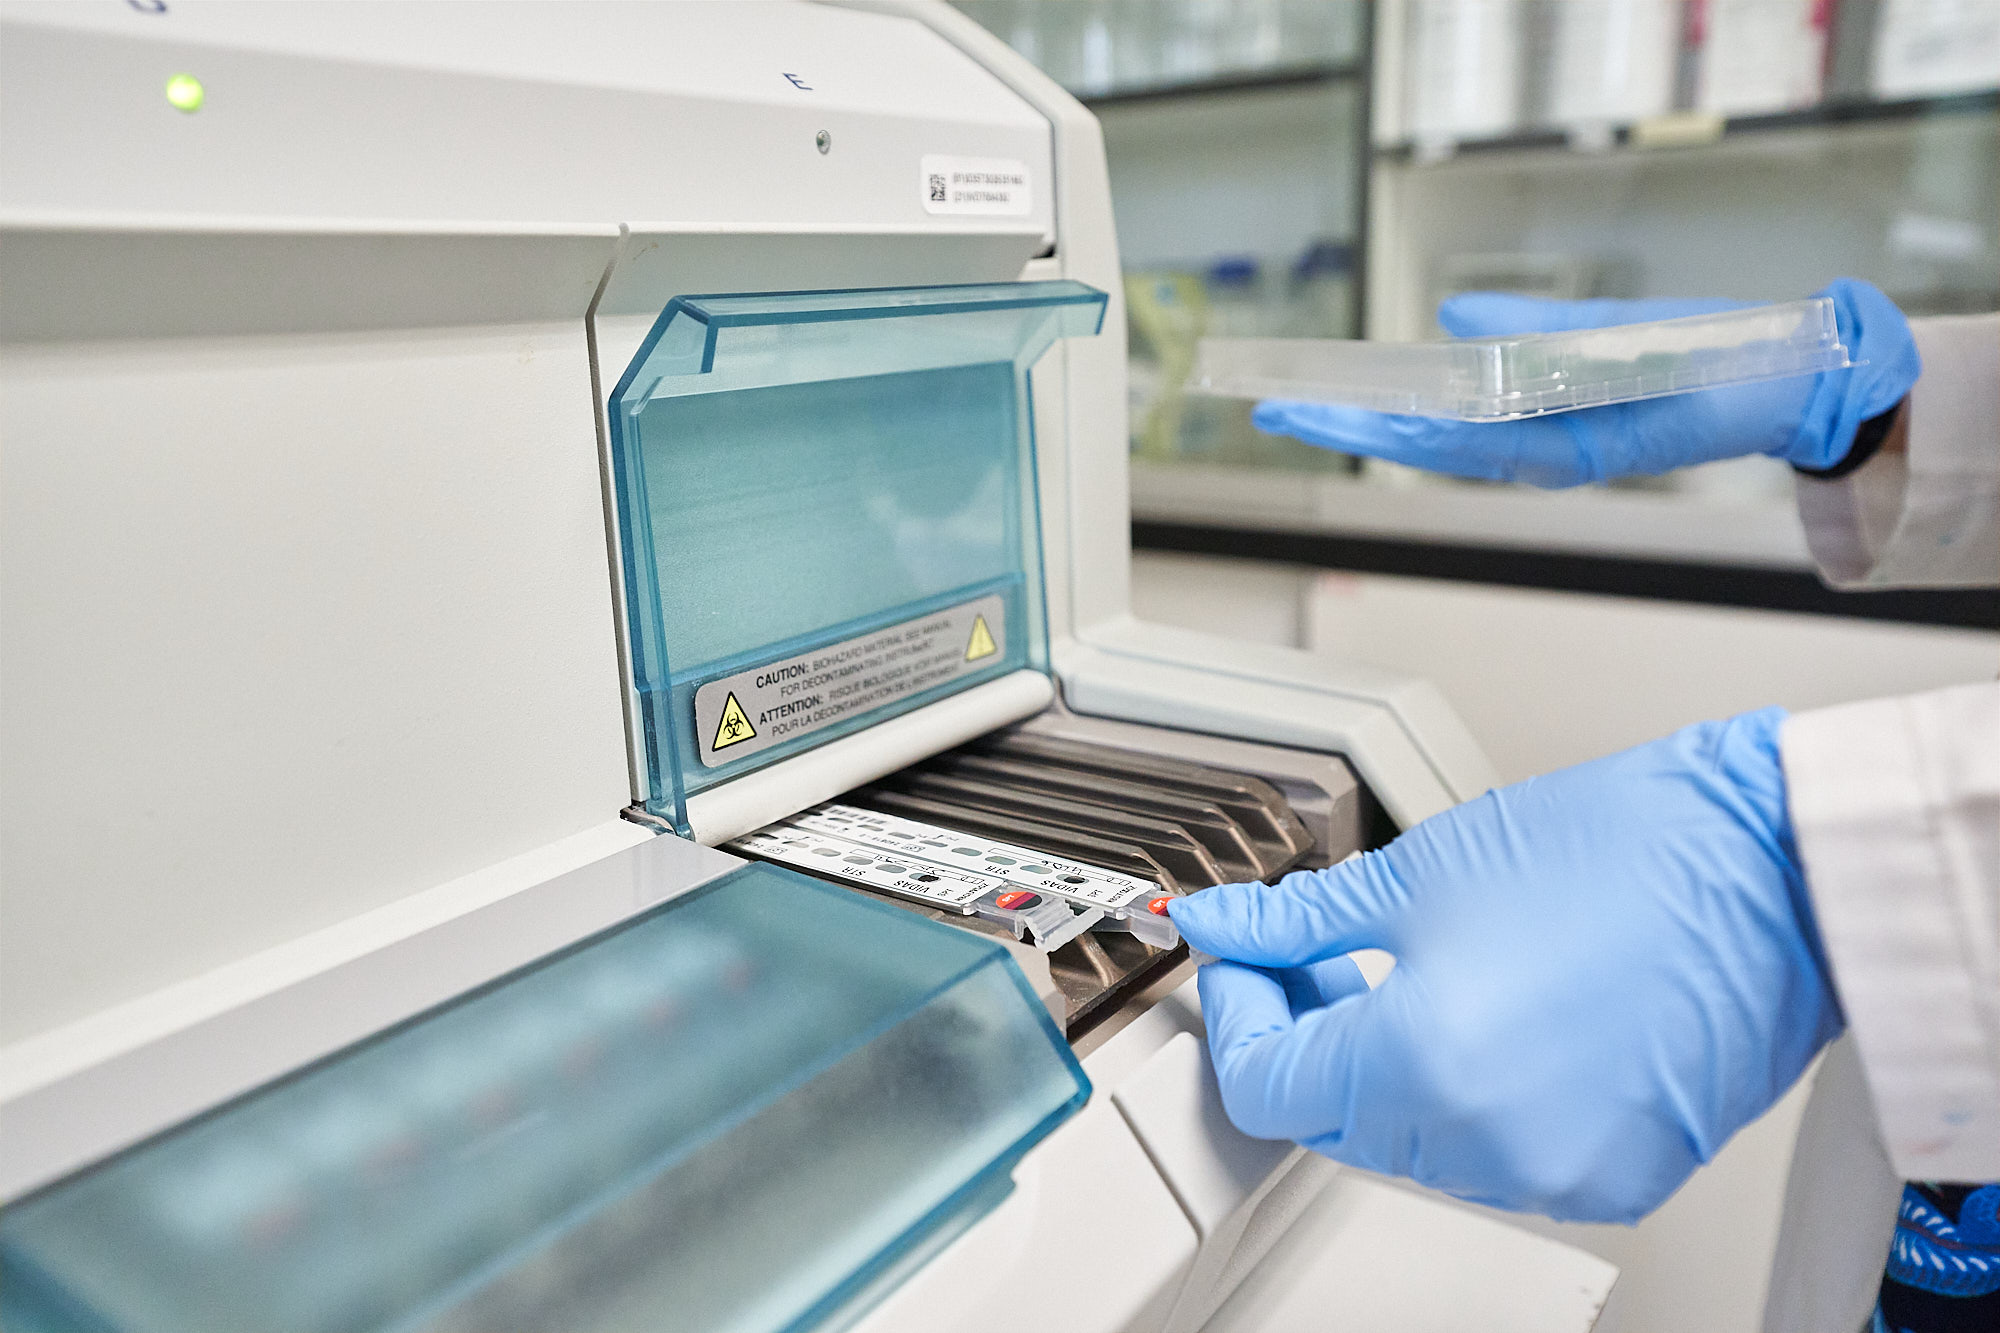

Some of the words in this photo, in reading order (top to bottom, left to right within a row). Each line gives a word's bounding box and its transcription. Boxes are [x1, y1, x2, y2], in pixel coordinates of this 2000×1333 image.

[782, 72, 814, 91] E
[756, 663, 809, 688] CAUTION:
[813, 648, 862, 671] BIOHAZARD
[780, 682, 801, 698] FOR
[802, 655, 883, 690] DECONTAMINATING
[759, 694, 825, 725] ATTENTION:
[828, 680, 861, 700] RISQUE
[771, 718, 799, 736] POUR
[800, 714, 813, 727] LA
[842, 866, 866, 877] STR
[985, 865, 1010, 876] STR
[894, 880, 930, 893] VIDAS
[1040, 880, 1079, 894] VIDAS
